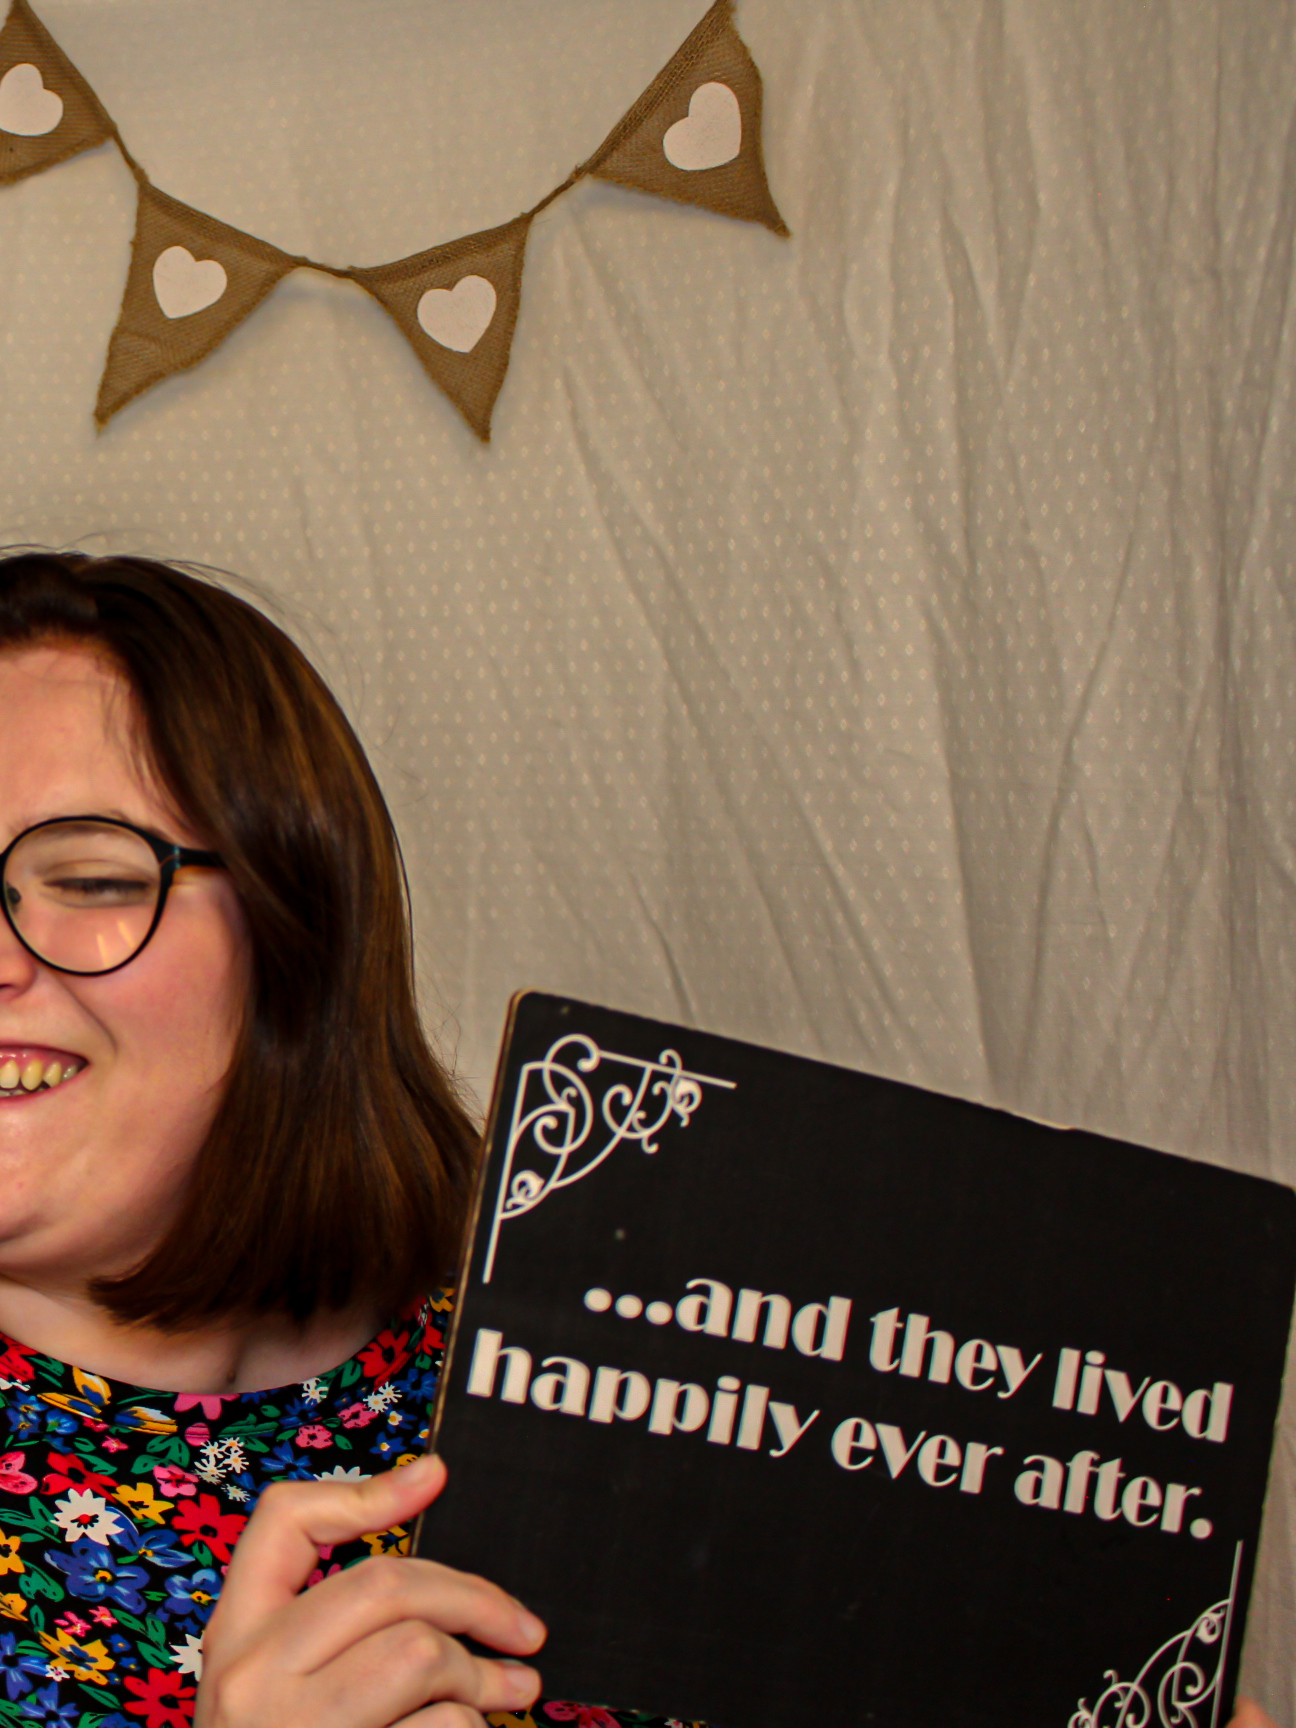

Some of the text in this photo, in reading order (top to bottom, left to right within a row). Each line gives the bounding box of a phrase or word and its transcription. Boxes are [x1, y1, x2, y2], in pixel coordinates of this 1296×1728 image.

[466, 1328, 1213, 1540] happily ever after.
[584, 1278, 1233, 1443] ...and they lived
